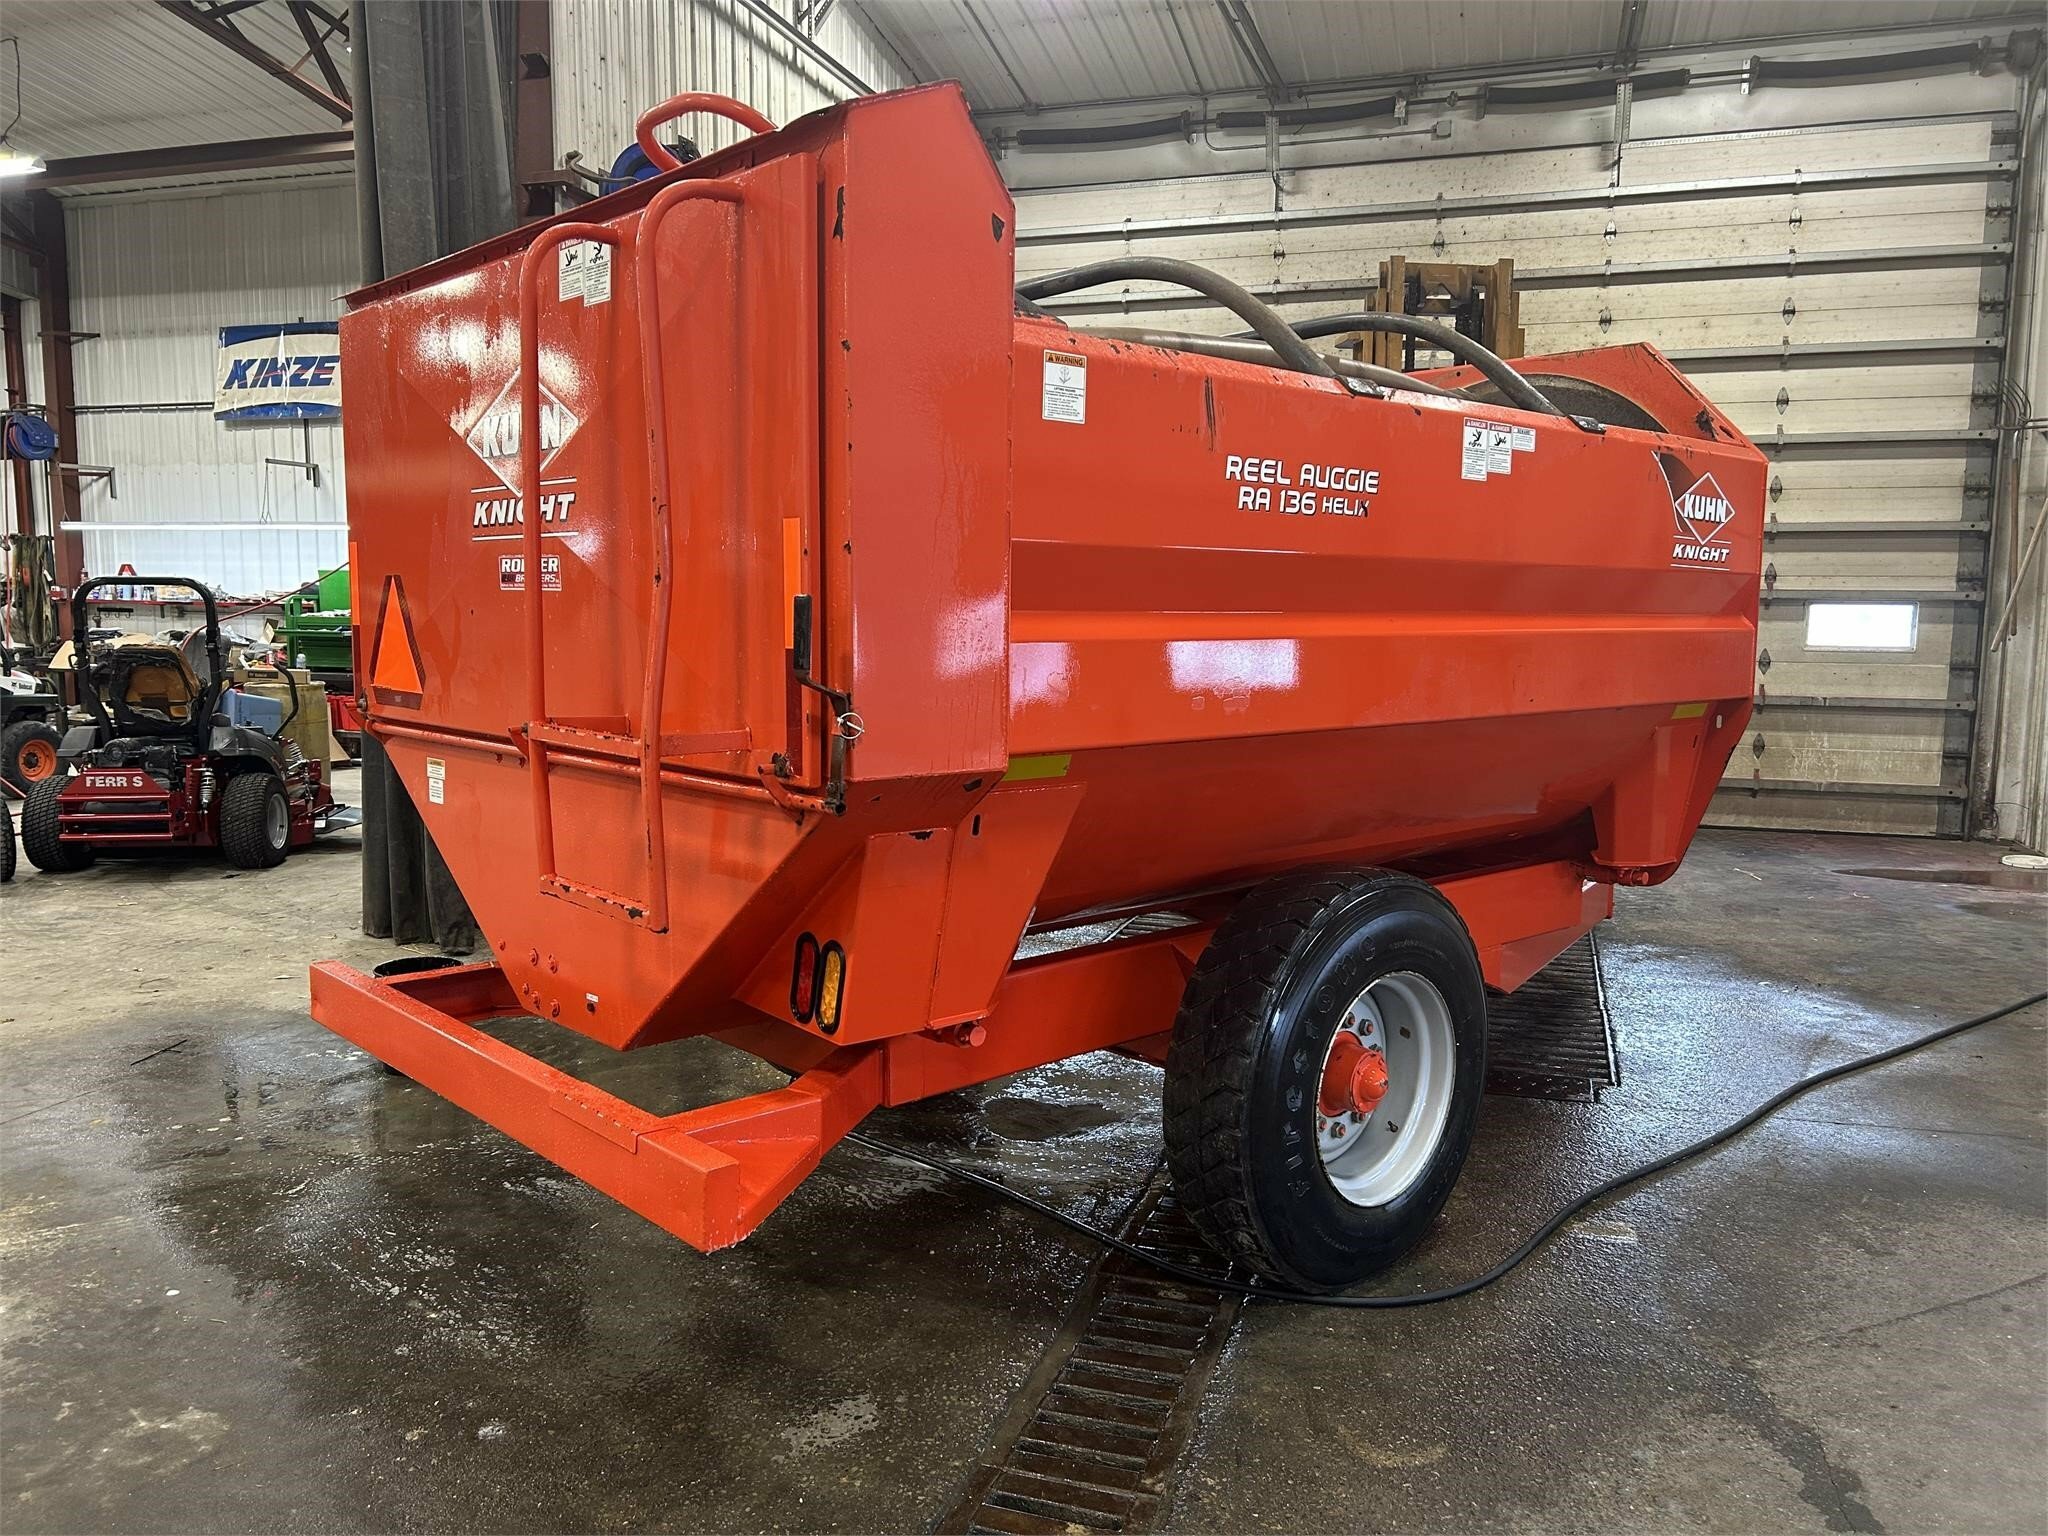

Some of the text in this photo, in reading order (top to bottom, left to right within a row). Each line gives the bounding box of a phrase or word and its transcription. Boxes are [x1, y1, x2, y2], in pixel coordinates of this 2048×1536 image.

[223, 355, 340, 389] KINZE
[1054, 354, 1083, 366] WARNING
[482, 403, 560, 458] KUN
[1225, 455, 1380, 494] REEL AUGGIE
[473, 493, 576, 527] KNIHT
[1238, 486, 1369, 517] RA 136 HELIX
[1684, 493, 1726, 523] KUHN
[1672, 543, 1729, 563] KNIGHT
